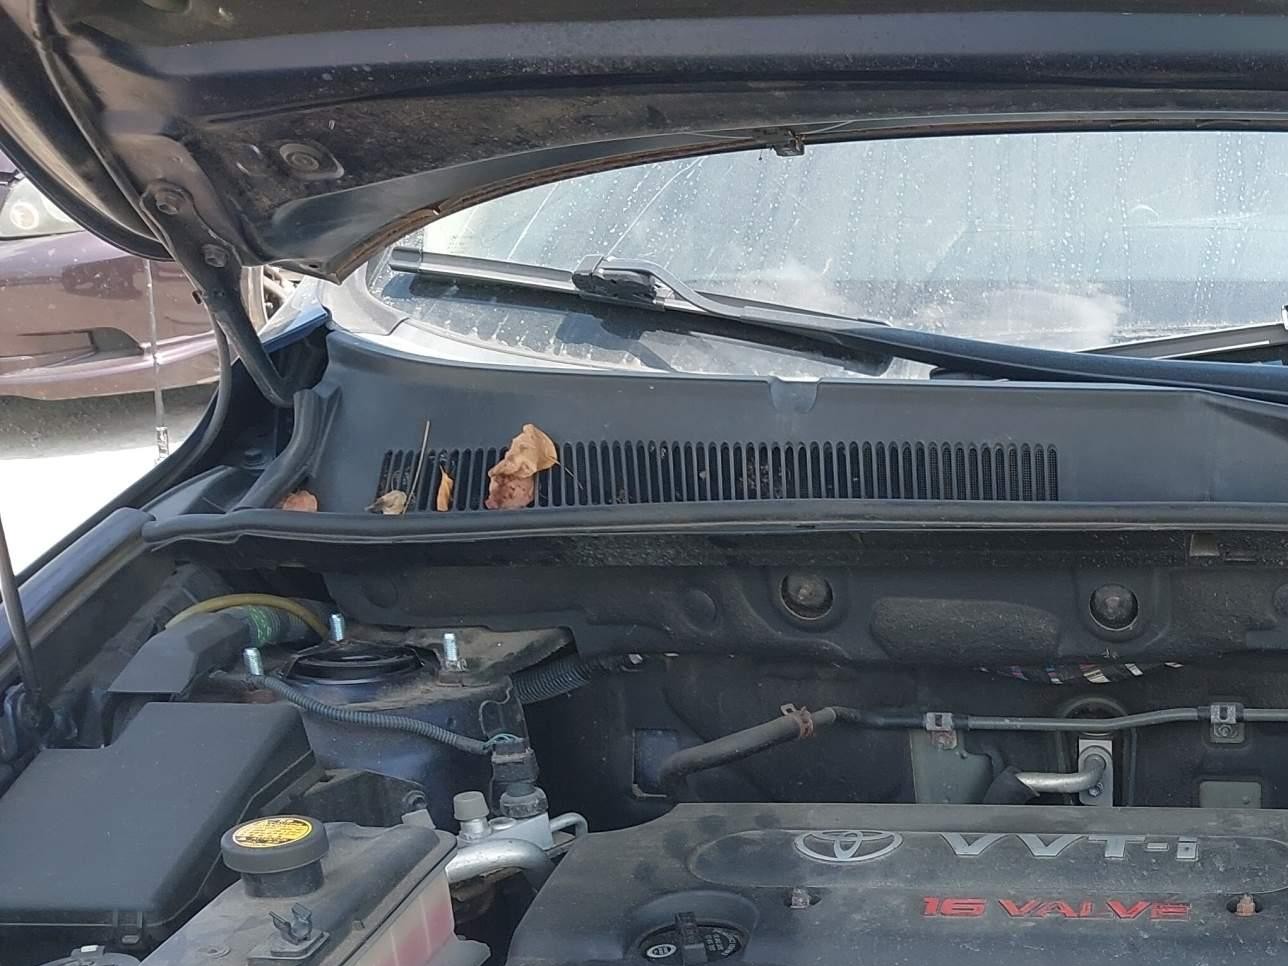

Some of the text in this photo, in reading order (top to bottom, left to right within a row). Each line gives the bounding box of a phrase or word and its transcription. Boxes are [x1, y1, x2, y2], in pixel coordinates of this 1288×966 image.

[940, 833, 1199, 861] VVT-i
[922, 896, 1193, 921] 16 VALVE
